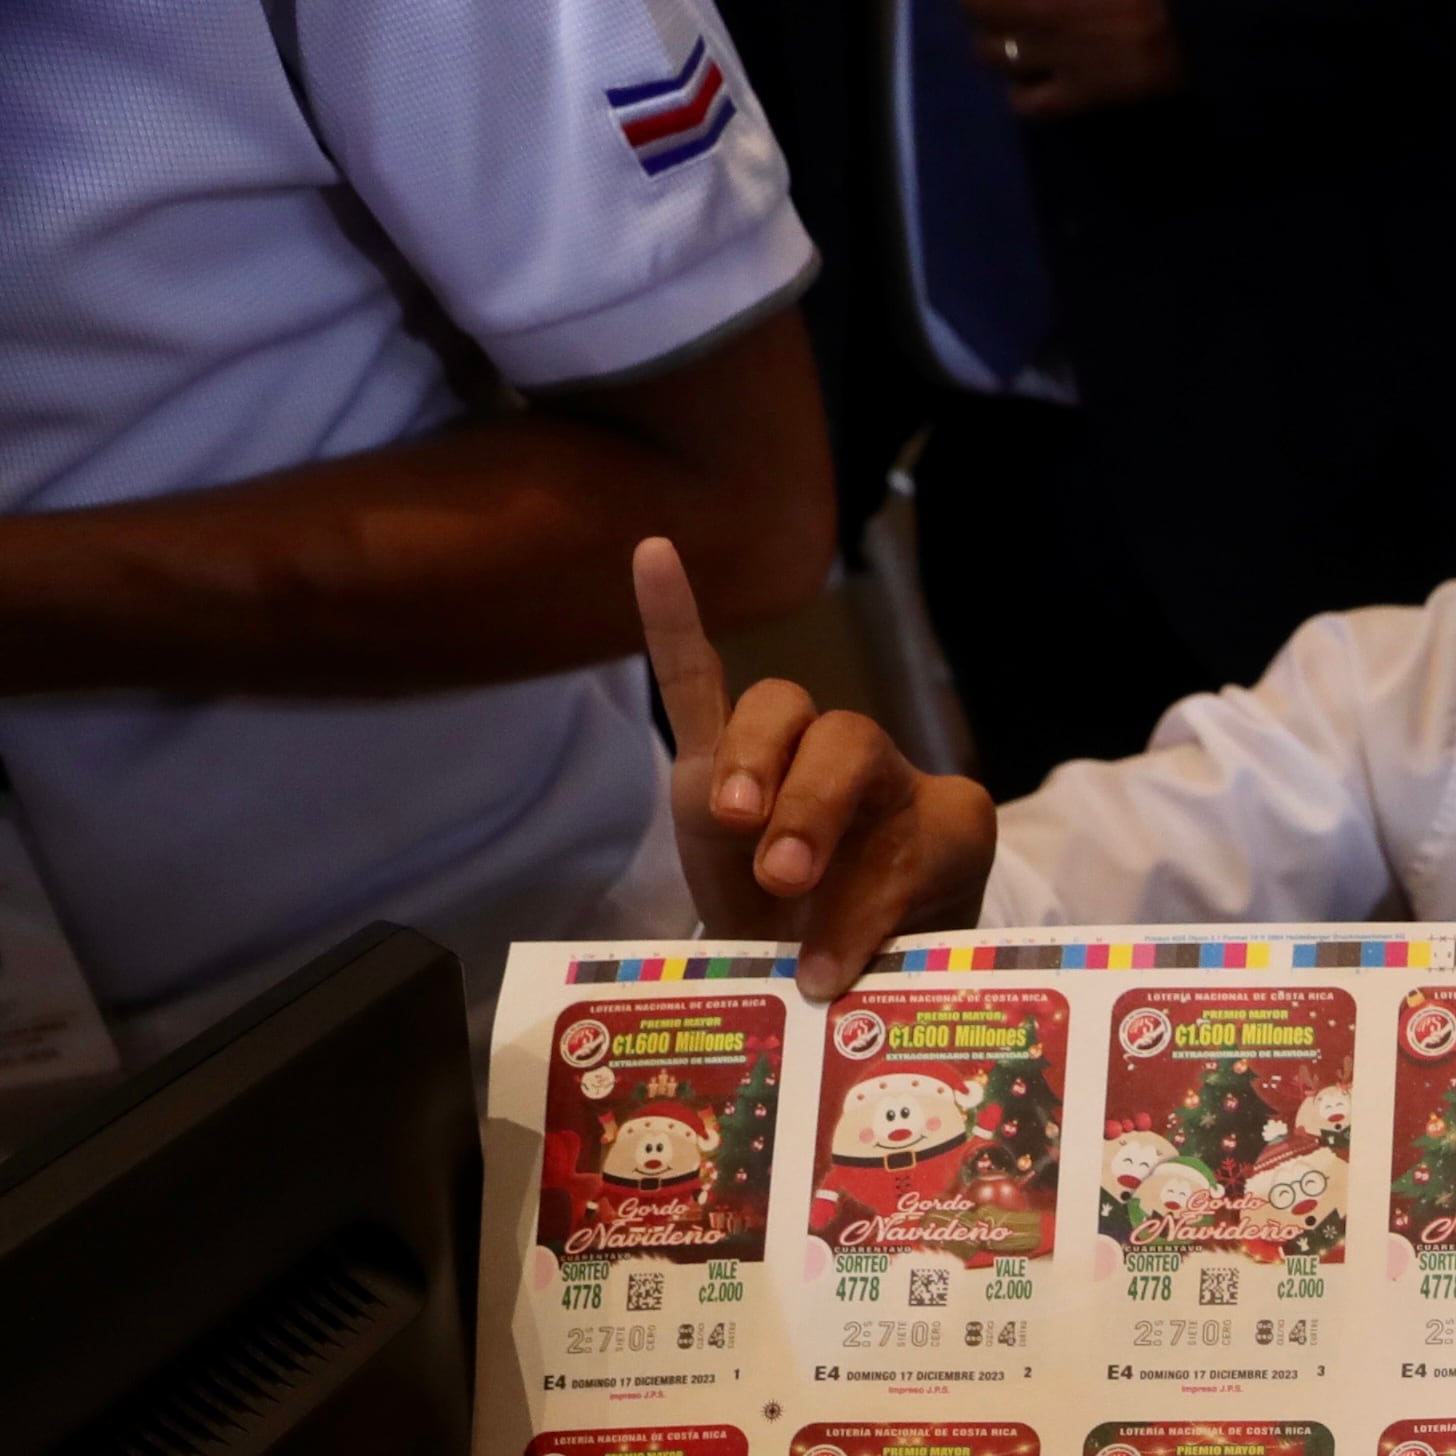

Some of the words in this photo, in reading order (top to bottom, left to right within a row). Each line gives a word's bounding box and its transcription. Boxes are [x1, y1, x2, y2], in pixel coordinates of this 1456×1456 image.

[1241, 1024, 1314, 1045] Millones
[561, 1262, 610, 1282] SORTEO
[708, 1261, 737, 1280] VALE
[561, 1284, 602, 1310] 4778
[815, 1366, 840, 1381] E4
[846, 1372, 896, 1381] DOMINGO
[901, 1372, 912, 1381] 17
[917, 1372, 975, 1380] DICIEMBRE
[979, 1372, 1004, 1380] 2023
[1024, 1367, 1032, 1378] 2
[883, 1447, 928, 1456] PREMIO
[930, 1447, 970, 1456] MAYOR
